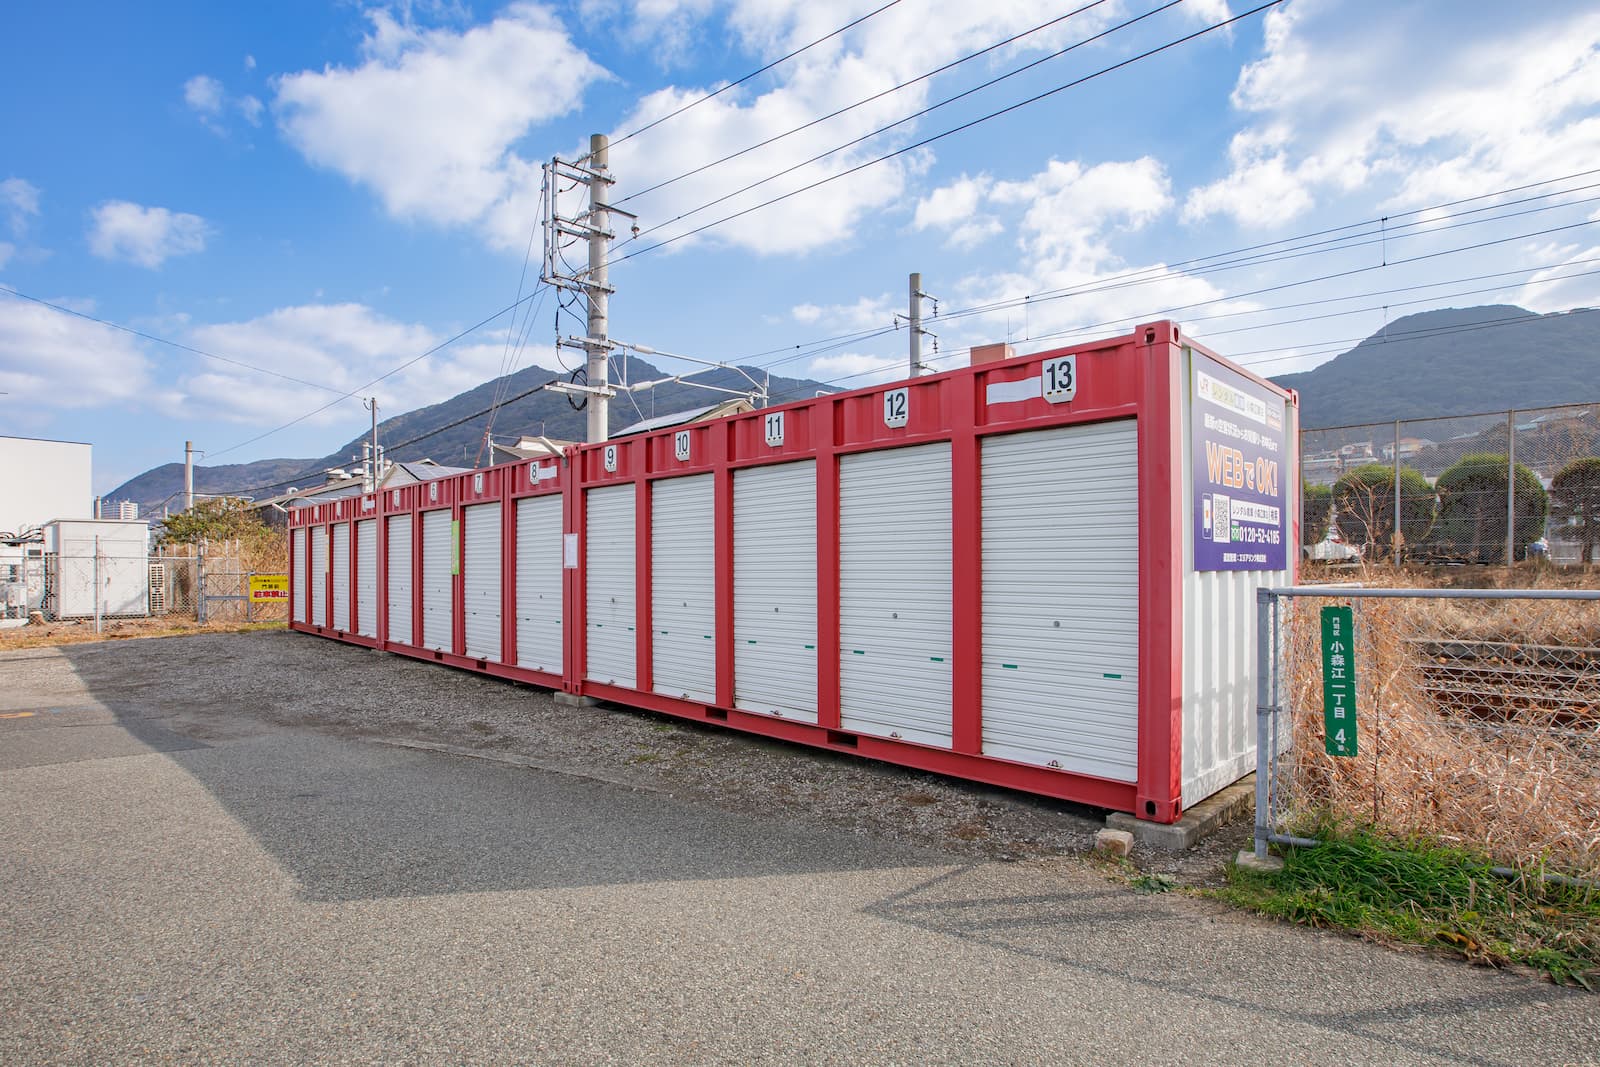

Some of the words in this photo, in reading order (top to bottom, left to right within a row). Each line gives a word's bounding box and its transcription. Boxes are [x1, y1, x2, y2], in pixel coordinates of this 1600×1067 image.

[1046, 361, 1073, 390] 13
[886, 392, 905, 417] 12
[767, 416, 780, 437] 11
[677, 433, 688, 452] 10
[607, 448, 614, 464] 9
[531, 464, 537, 478] 8
[476, 475, 481, 490] 7
[1239, 526, 1280, 545] 0120-52-4185
[1330, 641, 1346, 719] 小森江一丁目
